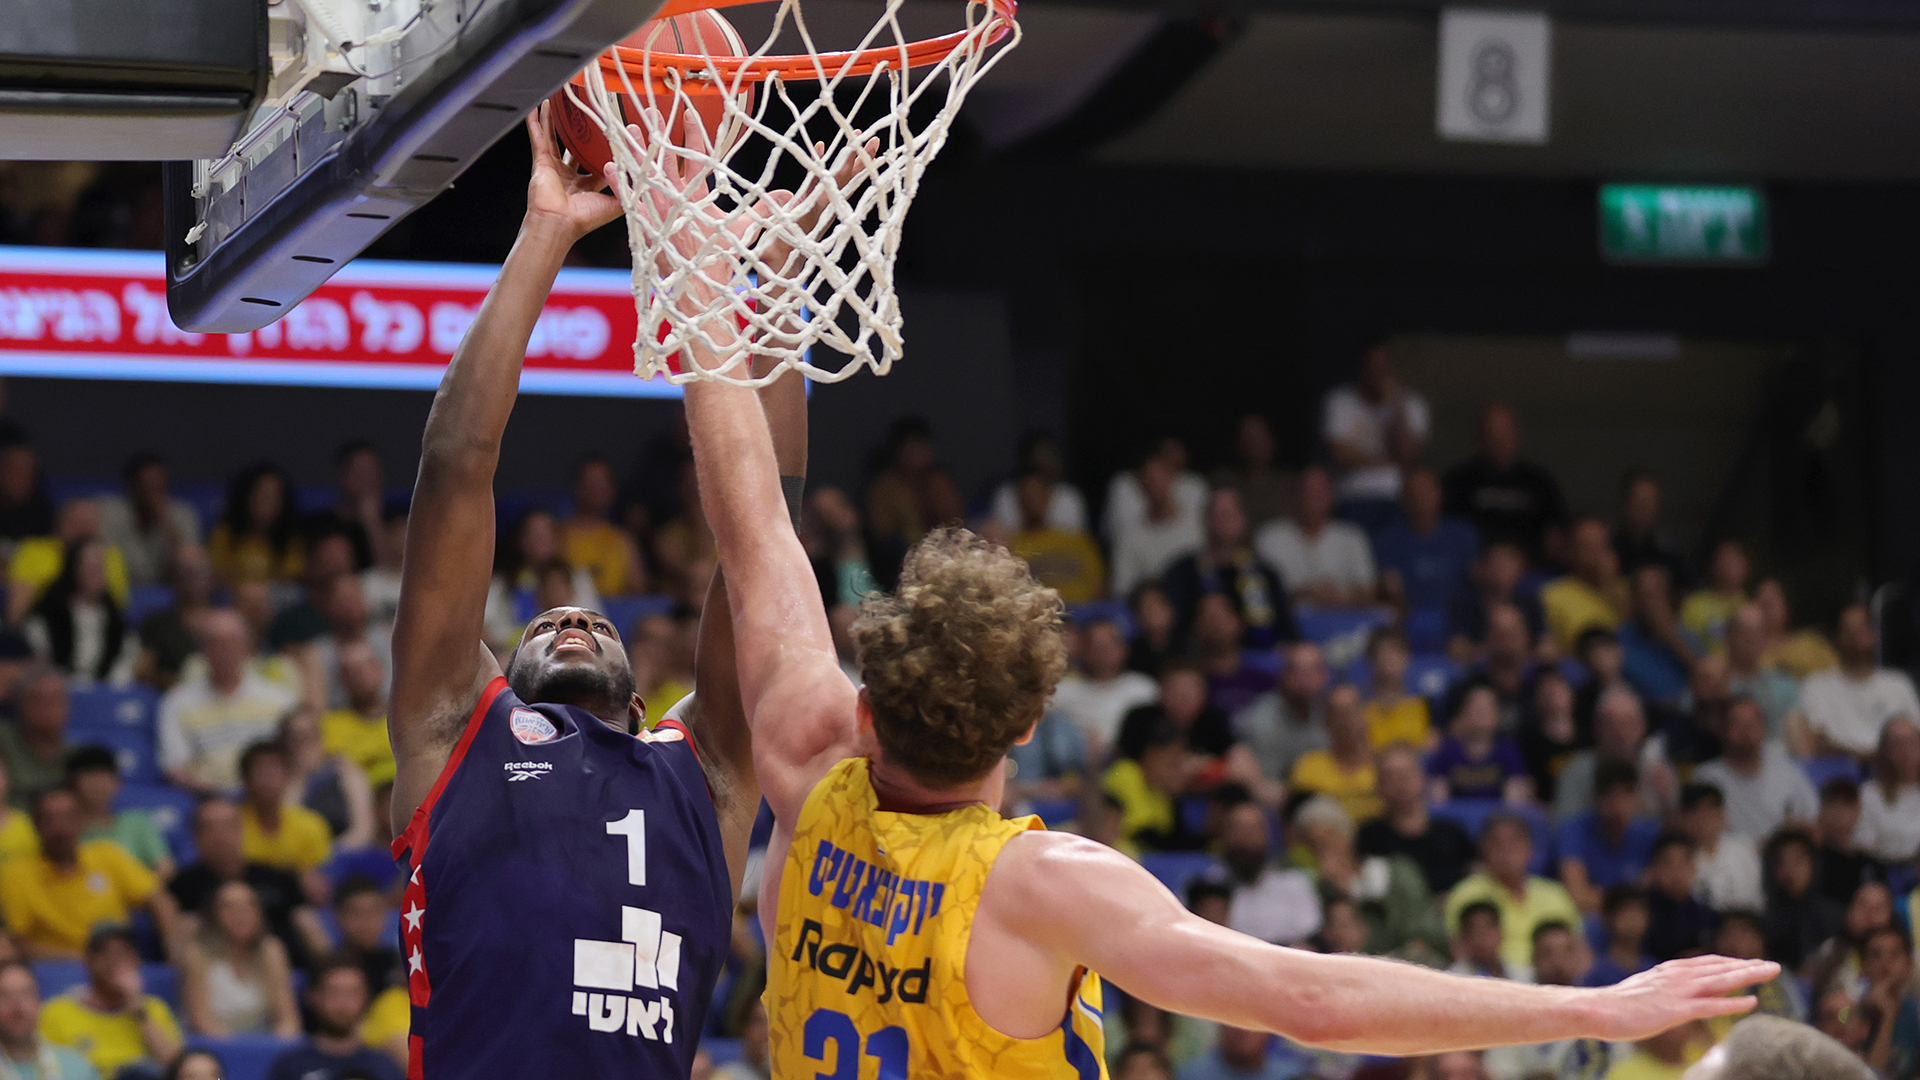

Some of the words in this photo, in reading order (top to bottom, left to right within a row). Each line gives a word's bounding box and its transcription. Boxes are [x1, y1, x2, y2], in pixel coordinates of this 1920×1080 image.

[1470, 41, 1517, 124] 8
[350, 292, 424, 353] כל
[504, 761, 553, 771] Reebok
[606, 808, 647, 886] 1
[791, 918, 931, 1004] Rapyd
[572, 991, 674, 1044] לאטי
